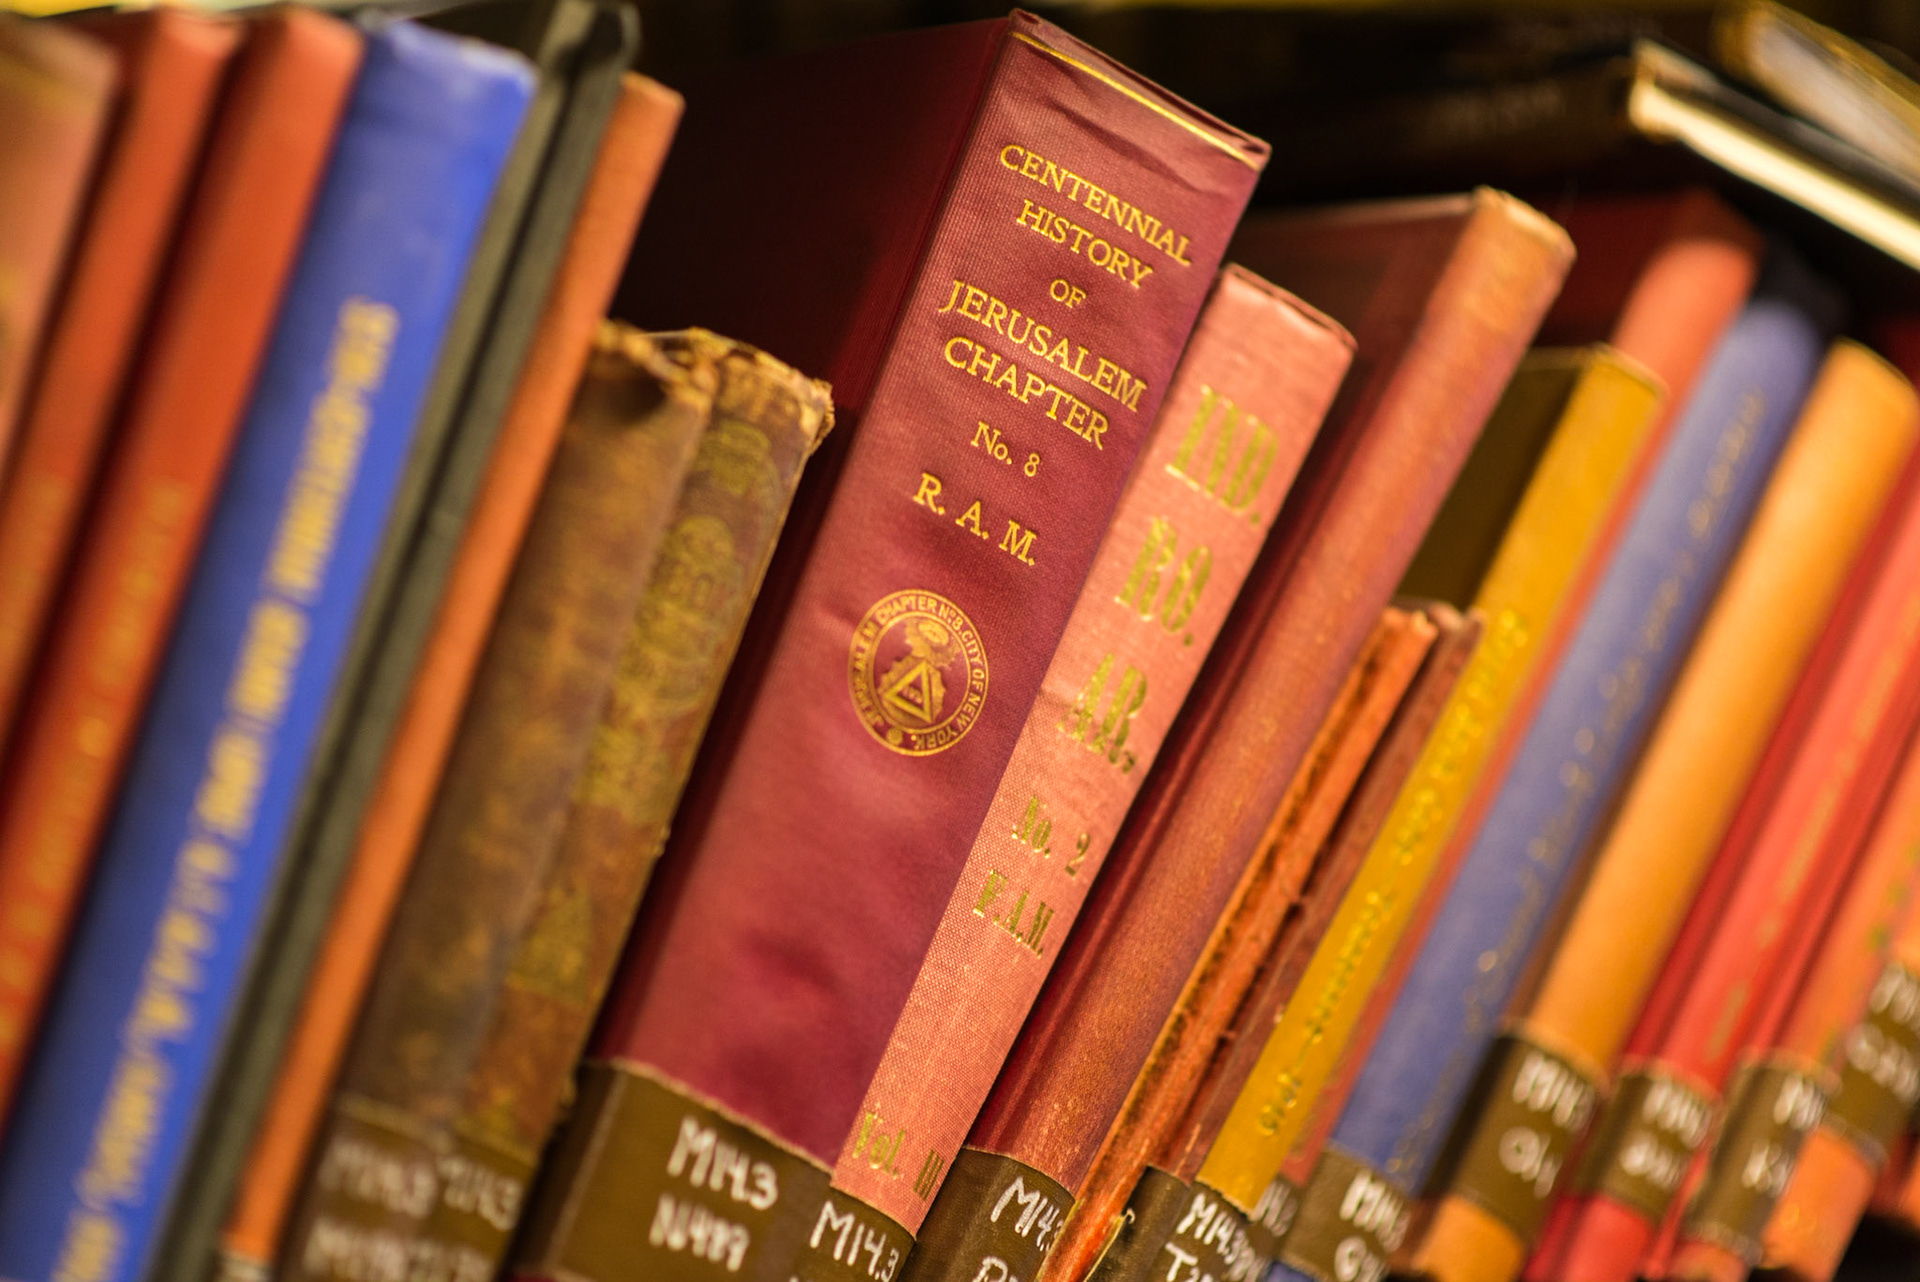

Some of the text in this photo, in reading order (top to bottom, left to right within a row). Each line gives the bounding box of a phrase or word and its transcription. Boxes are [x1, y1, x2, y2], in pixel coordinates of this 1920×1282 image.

[1000, 144, 1191, 267] CENTENNIAL
[1016, 199, 1154, 289] HISTORY
[1049, 278, 1087, 310] OF
[938, 280, 1148, 412] JERUSALEM
[944, 336, 1110, 450] CHAPTER
[970, 421, 1041, 478] No. 8
[913, 472, 1038, 567] R. A. M.
[1065, 831, 1091, 880] 2
[851, 1106, 906, 1181] Vol.
[809, 1200, 900, 1282] M14.3
